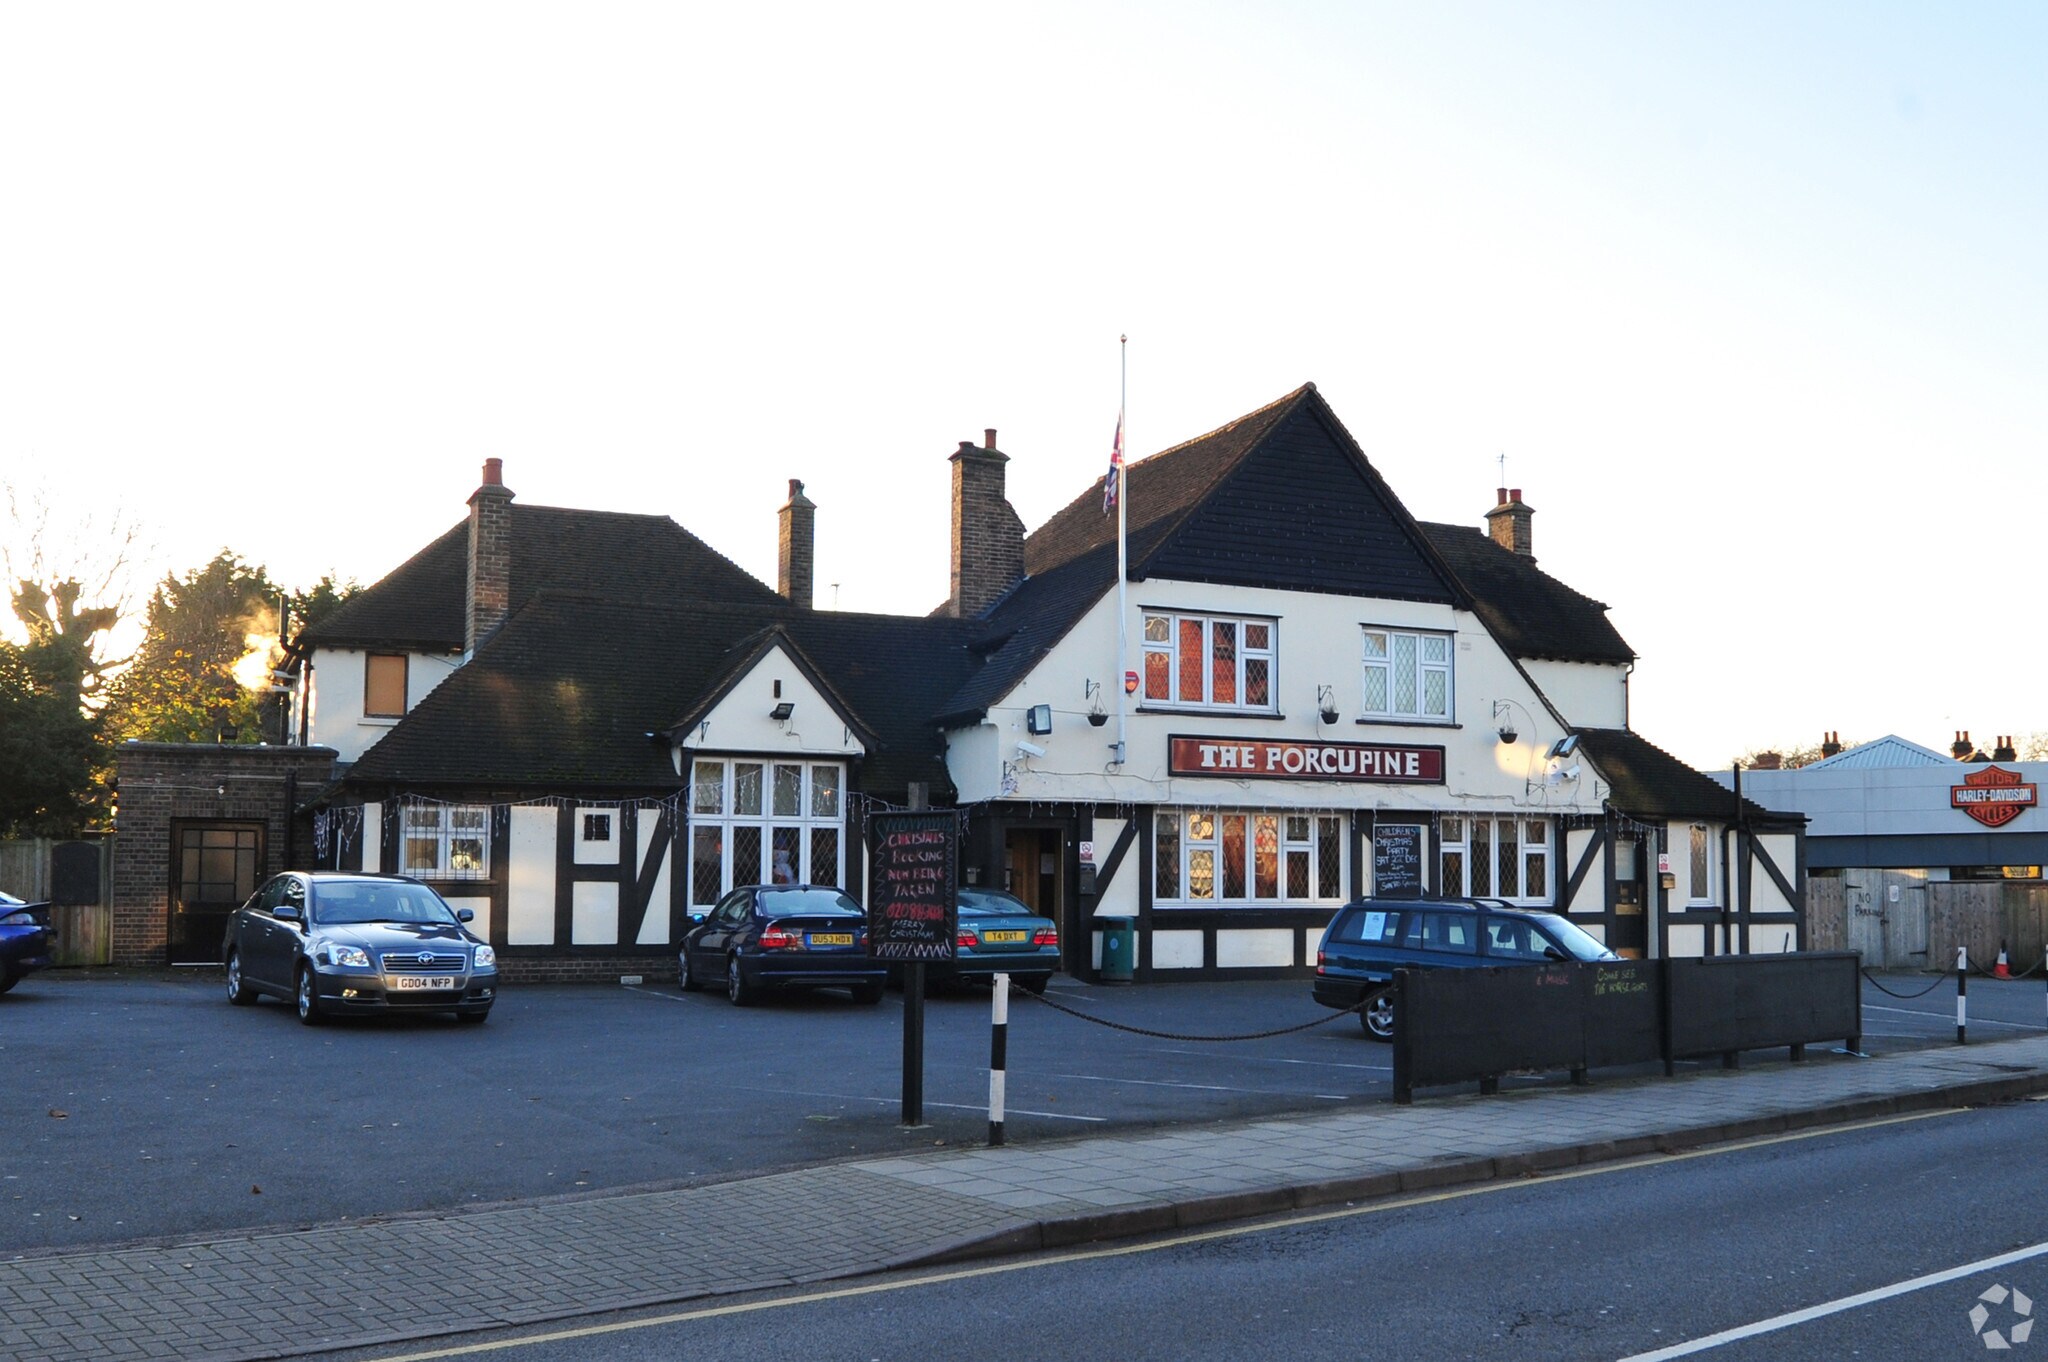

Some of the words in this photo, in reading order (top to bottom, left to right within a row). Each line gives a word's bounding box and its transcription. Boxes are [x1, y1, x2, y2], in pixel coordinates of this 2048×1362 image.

[1199, 745, 1255, 769] THE
[1266, 747, 1420, 776] PORCUPINE
[1973, 774, 2013, 785] MOTOR
[1956, 788, 2032, 803] HARLEY-DAVIDSON
[1972, 805, 2014, 822] CYCLES
[1386, 847, 1410, 856] PARTY
[1376, 856, 1389, 866] SAT
[1405, 855, 1418, 863] DEC
[1858, 893, 1871, 903] NO
[892, 919, 925, 929] MERRY
[431, 978, 450, 988] NFP
